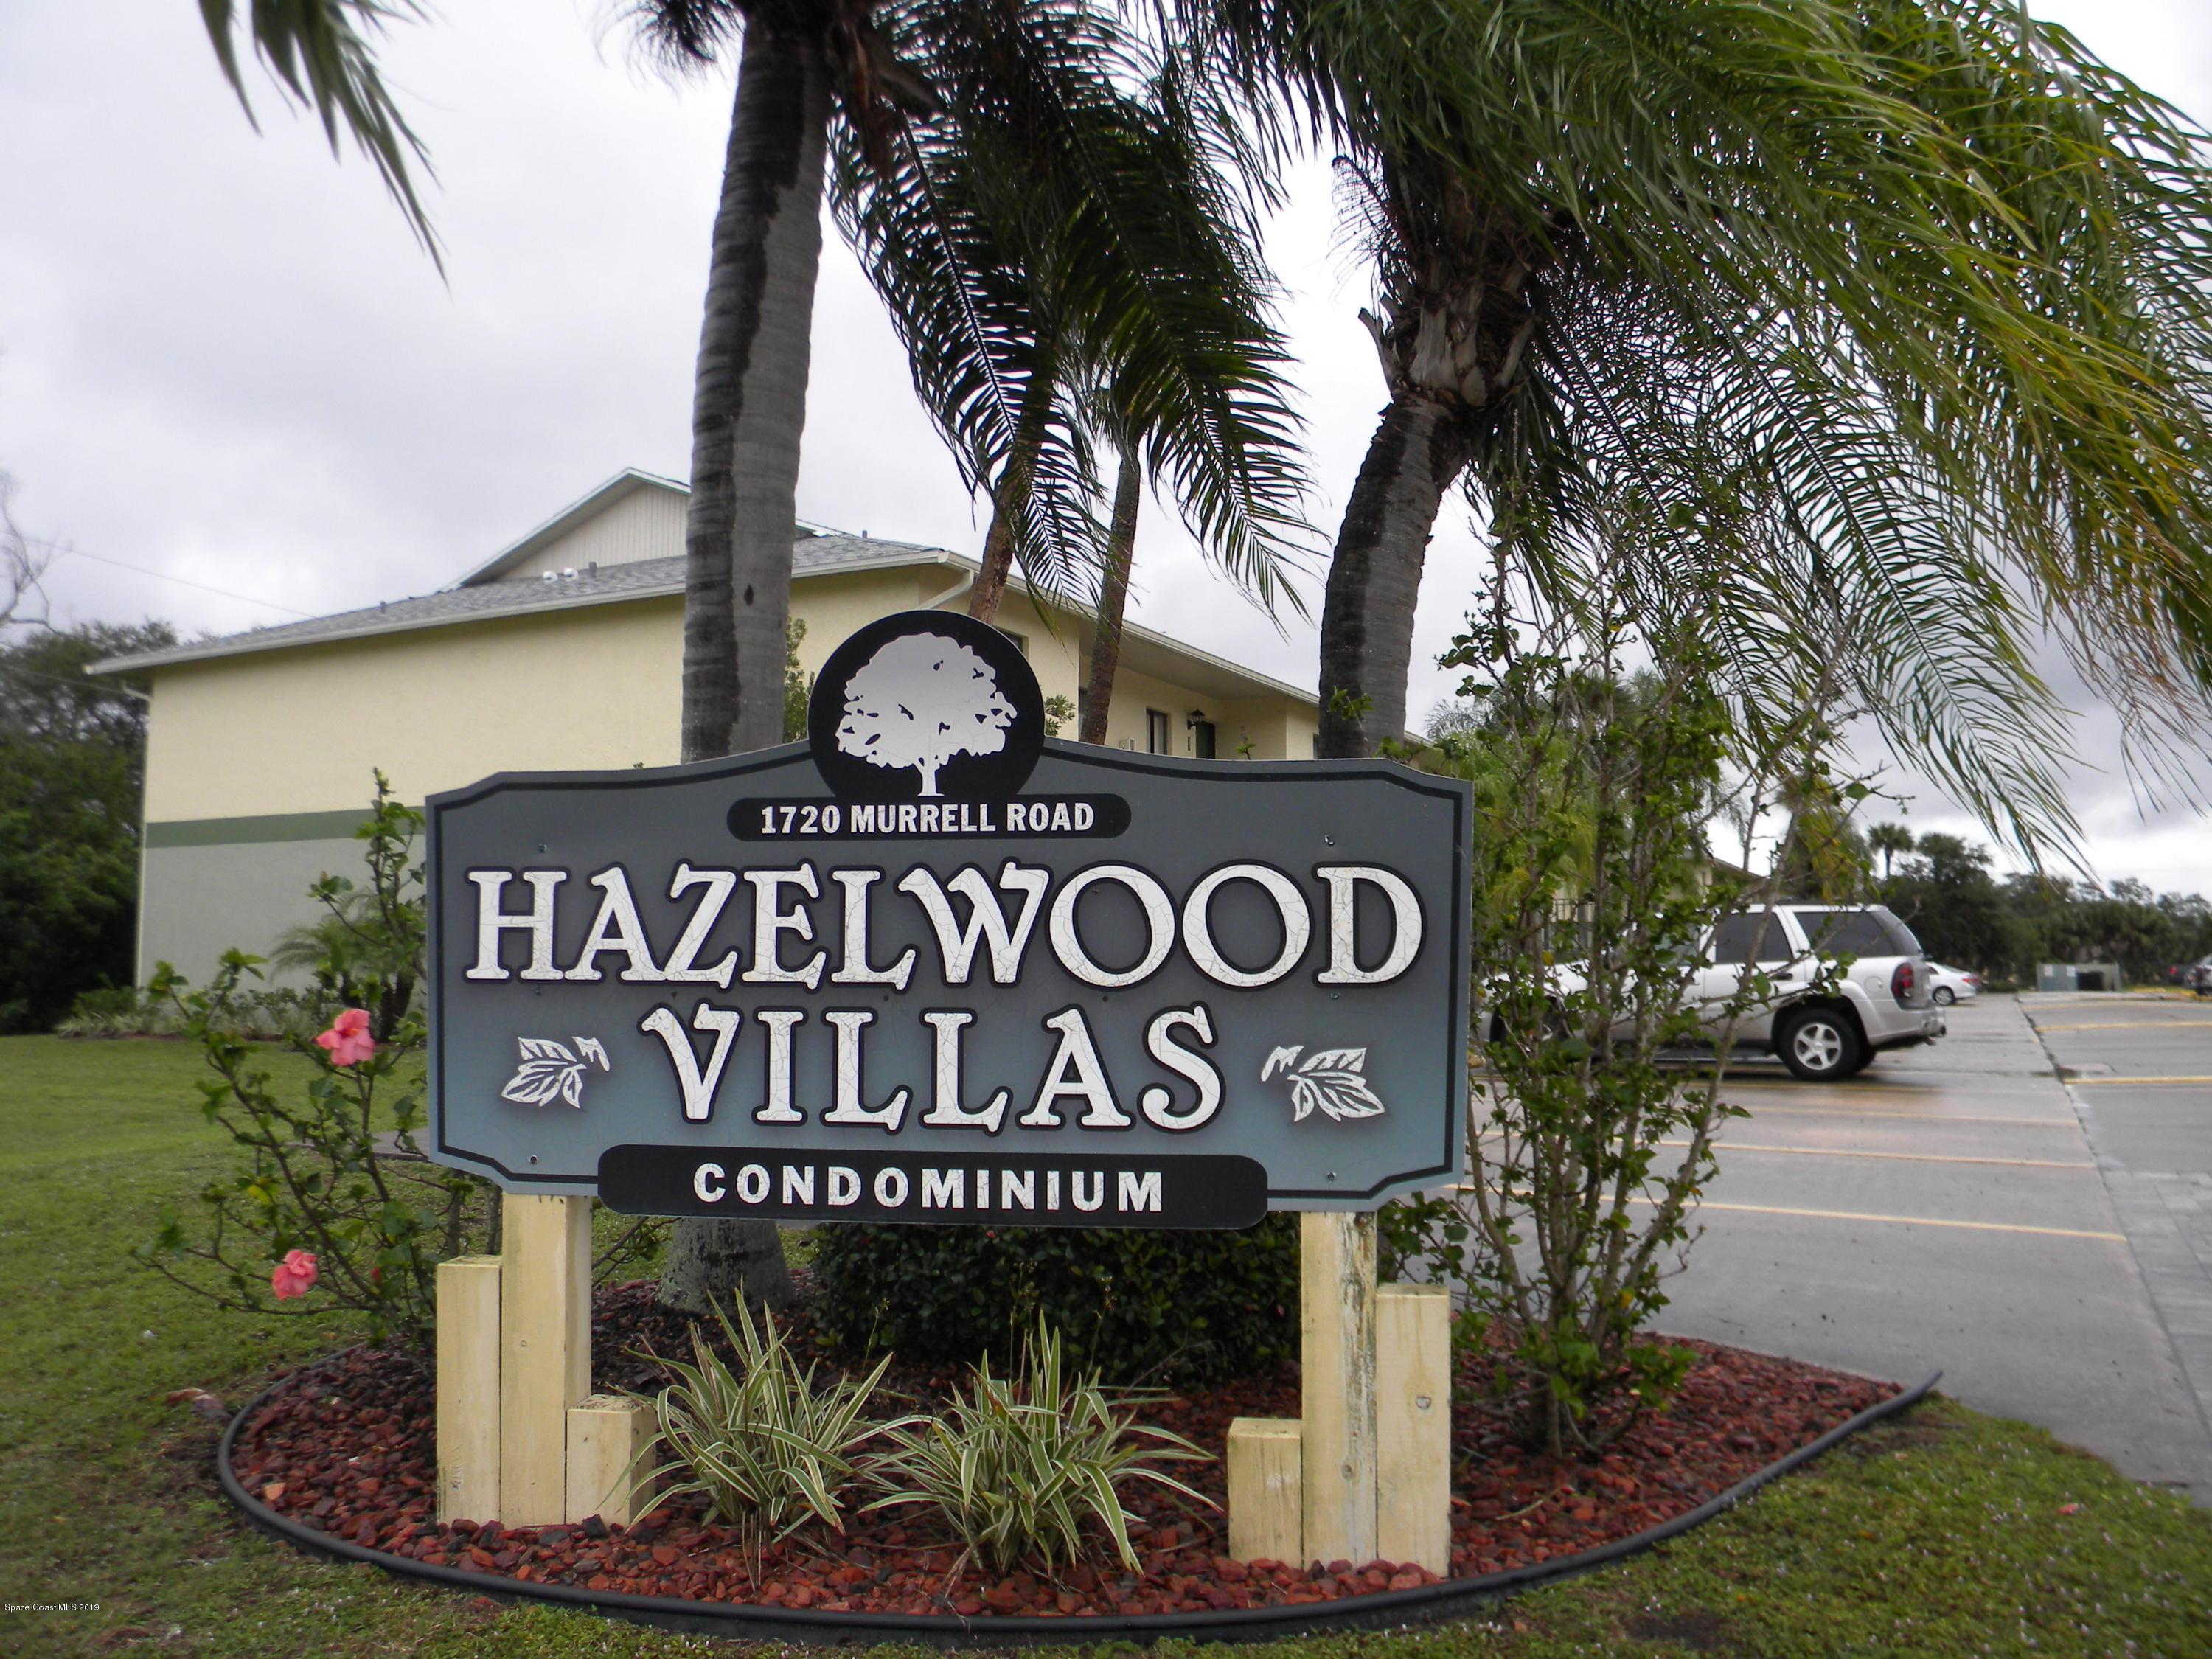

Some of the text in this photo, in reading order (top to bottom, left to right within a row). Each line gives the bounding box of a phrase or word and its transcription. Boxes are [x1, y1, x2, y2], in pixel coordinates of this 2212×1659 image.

[760, 801, 1094, 835] 1720 MURRELL ROAD
[465, 863, 1422, 990] HAZELWOOD
[641, 1004, 1221, 1131] VILLAS
[693, 1162, 1163, 1213] CONDOMINIUM
